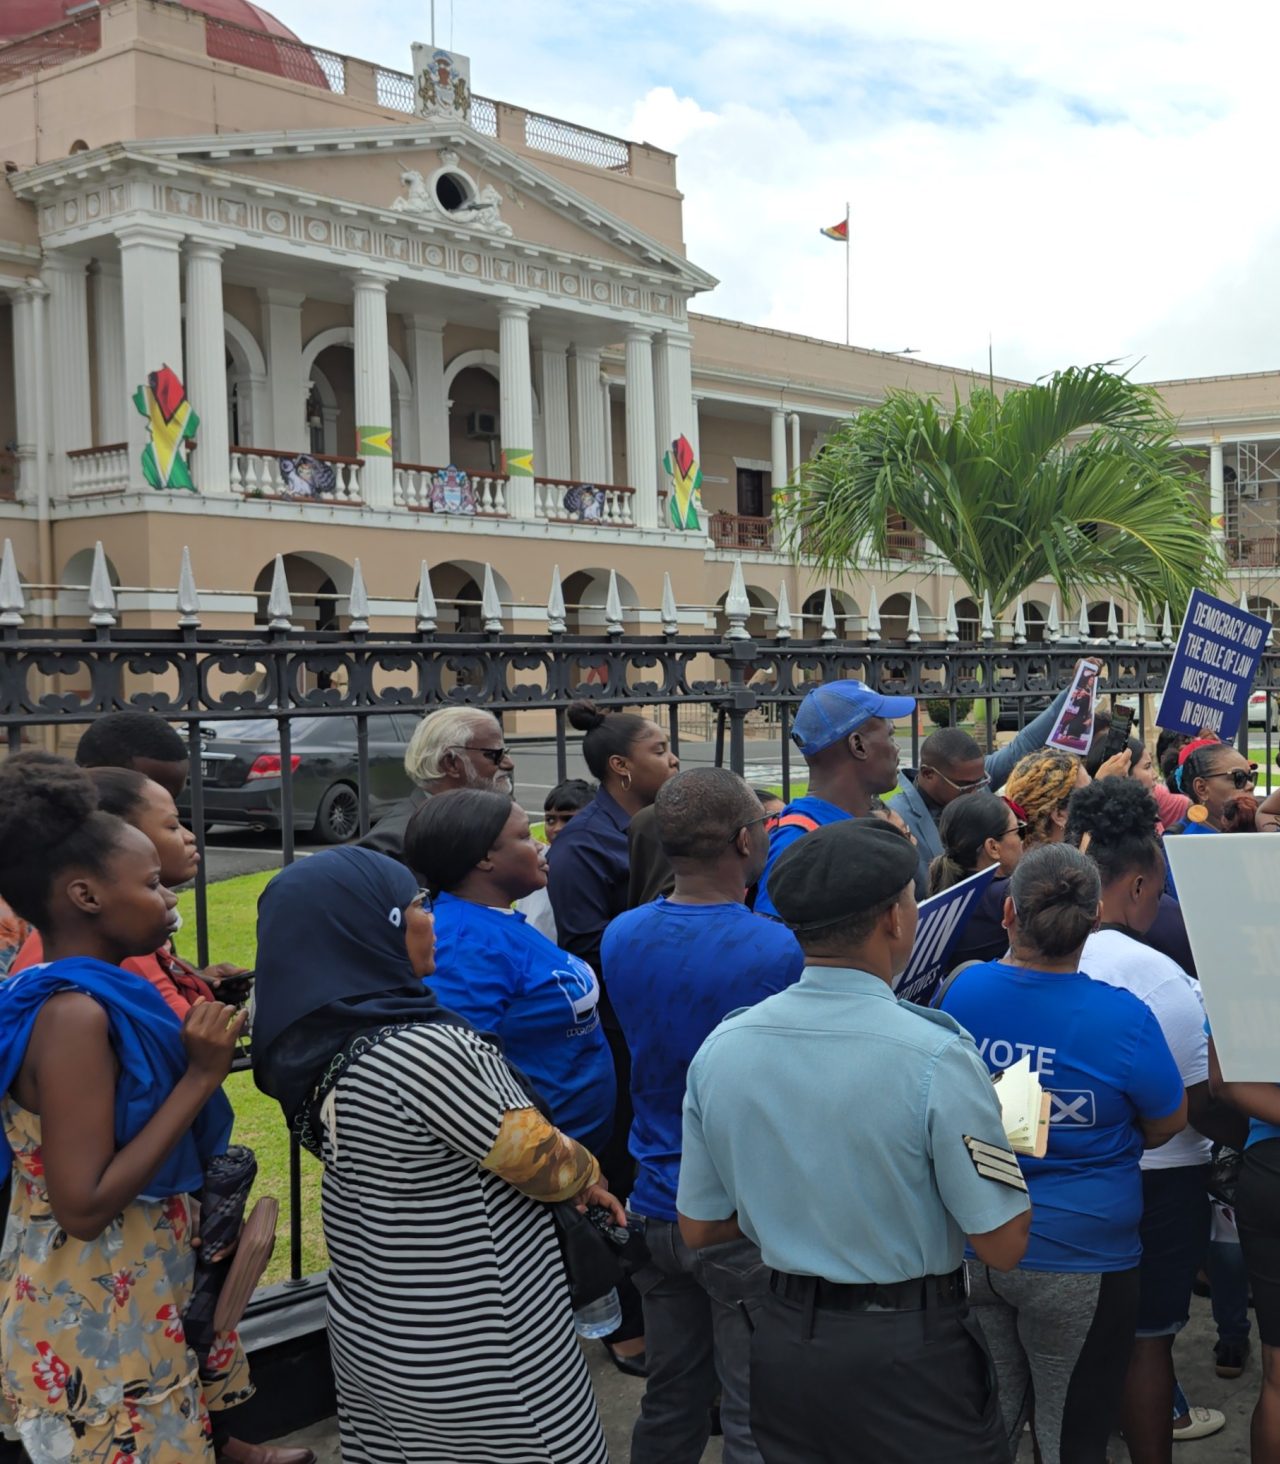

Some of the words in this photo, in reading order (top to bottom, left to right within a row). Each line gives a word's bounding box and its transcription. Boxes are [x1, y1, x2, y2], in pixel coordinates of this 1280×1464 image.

[1193, 602, 1246, 643] DEMOCRACY
[1241, 624, 1263, 650] AND
[1184, 633, 1202, 660] THE
[1200, 639, 1226, 668] RULE
[1221, 649, 1237, 672] OF
[1232, 653, 1253, 679] LAW
[1180, 666, 1207, 695] MUST
[1204, 675, 1238, 705] PREVAIL
[1180, 700, 1193, 723] IN
[1191, 703, 1224, 733] GUYANA
